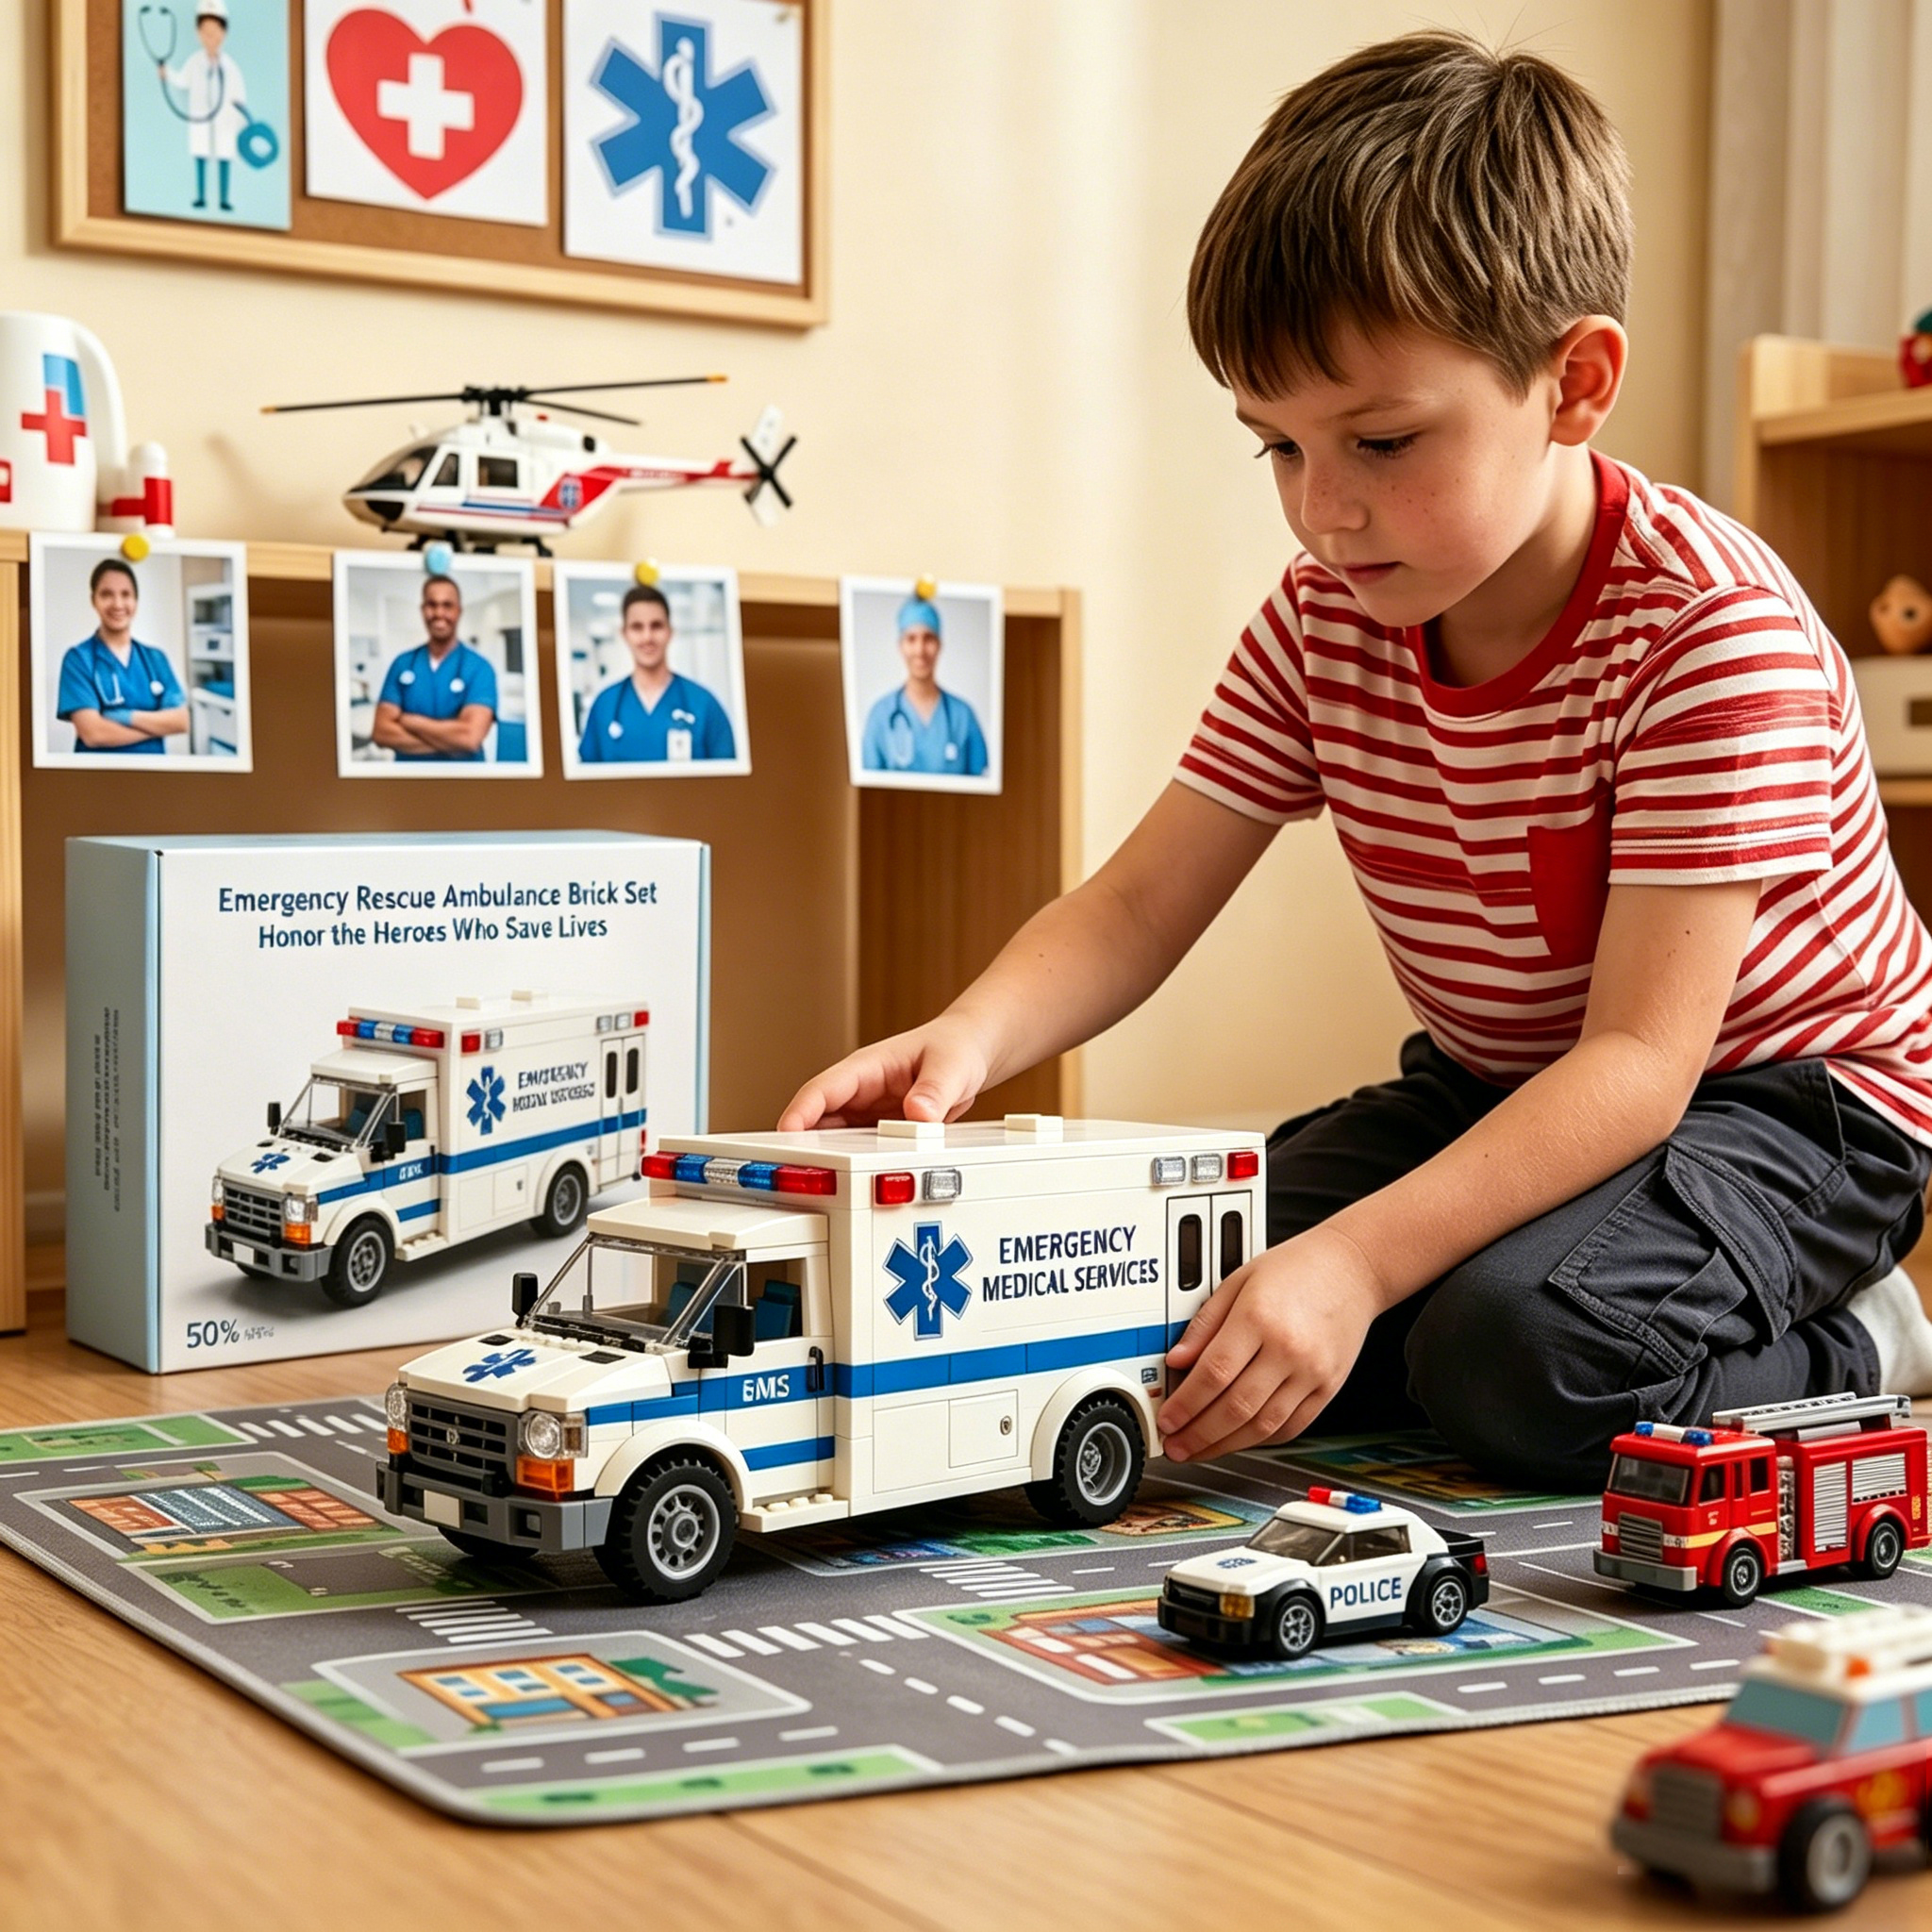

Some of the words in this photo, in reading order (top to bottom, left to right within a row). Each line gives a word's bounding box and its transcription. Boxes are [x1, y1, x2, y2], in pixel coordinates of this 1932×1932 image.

[219, 888, 349, 917] Emergency
[357, 885, 436, 911] Rescue
[442, 882, 561, 908] Ambulance
[568, 881, 619, 906] Brick
[625, 881, 658, 905] Set
[258, 924, 325, 948] Honor
[331, 923, 366, 945] the
[374, 921, 446, 943] Heroes
[453, 917, 499, 941] Who
[506, 916, 553, 940] Save
[558, 914, 608, 938] Lives
[999, 1224, 1137, 1264] EMERGENCY
[983, 1268, 1070, 1302] MEDICAL
[1074, 1257, 1159, 1292] SERVICES
[187, 1319, 240, 1348] 50%
[1330, 1576, 1403, 1610] POLICE
